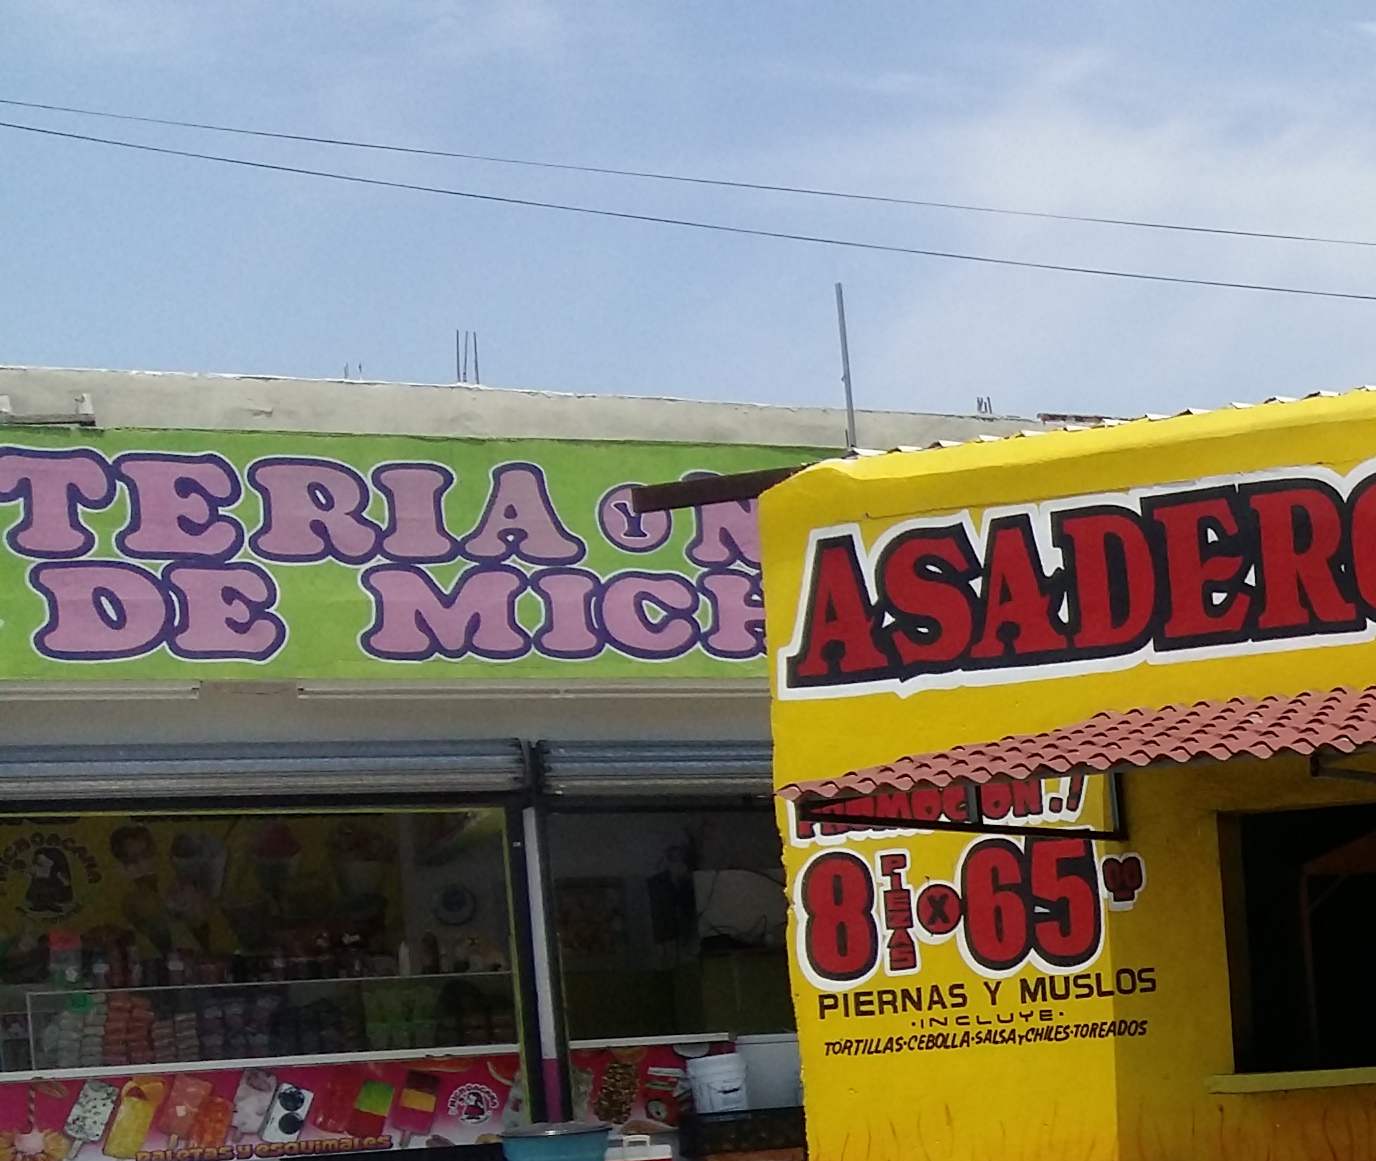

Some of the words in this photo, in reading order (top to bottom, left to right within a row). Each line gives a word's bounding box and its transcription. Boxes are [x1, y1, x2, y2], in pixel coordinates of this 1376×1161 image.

[28, 559, 287, 661] DE
[801, 851, 879, 982] 8
[879, 853, 917, 972] PIEZAS
[961, 837, 1102, 971] 65
[818, 983, 966, 1019] PIERNAS
[983, 980, 1002, 1006] Y
[1020, 967, 1157, 1004] MUSLOS
